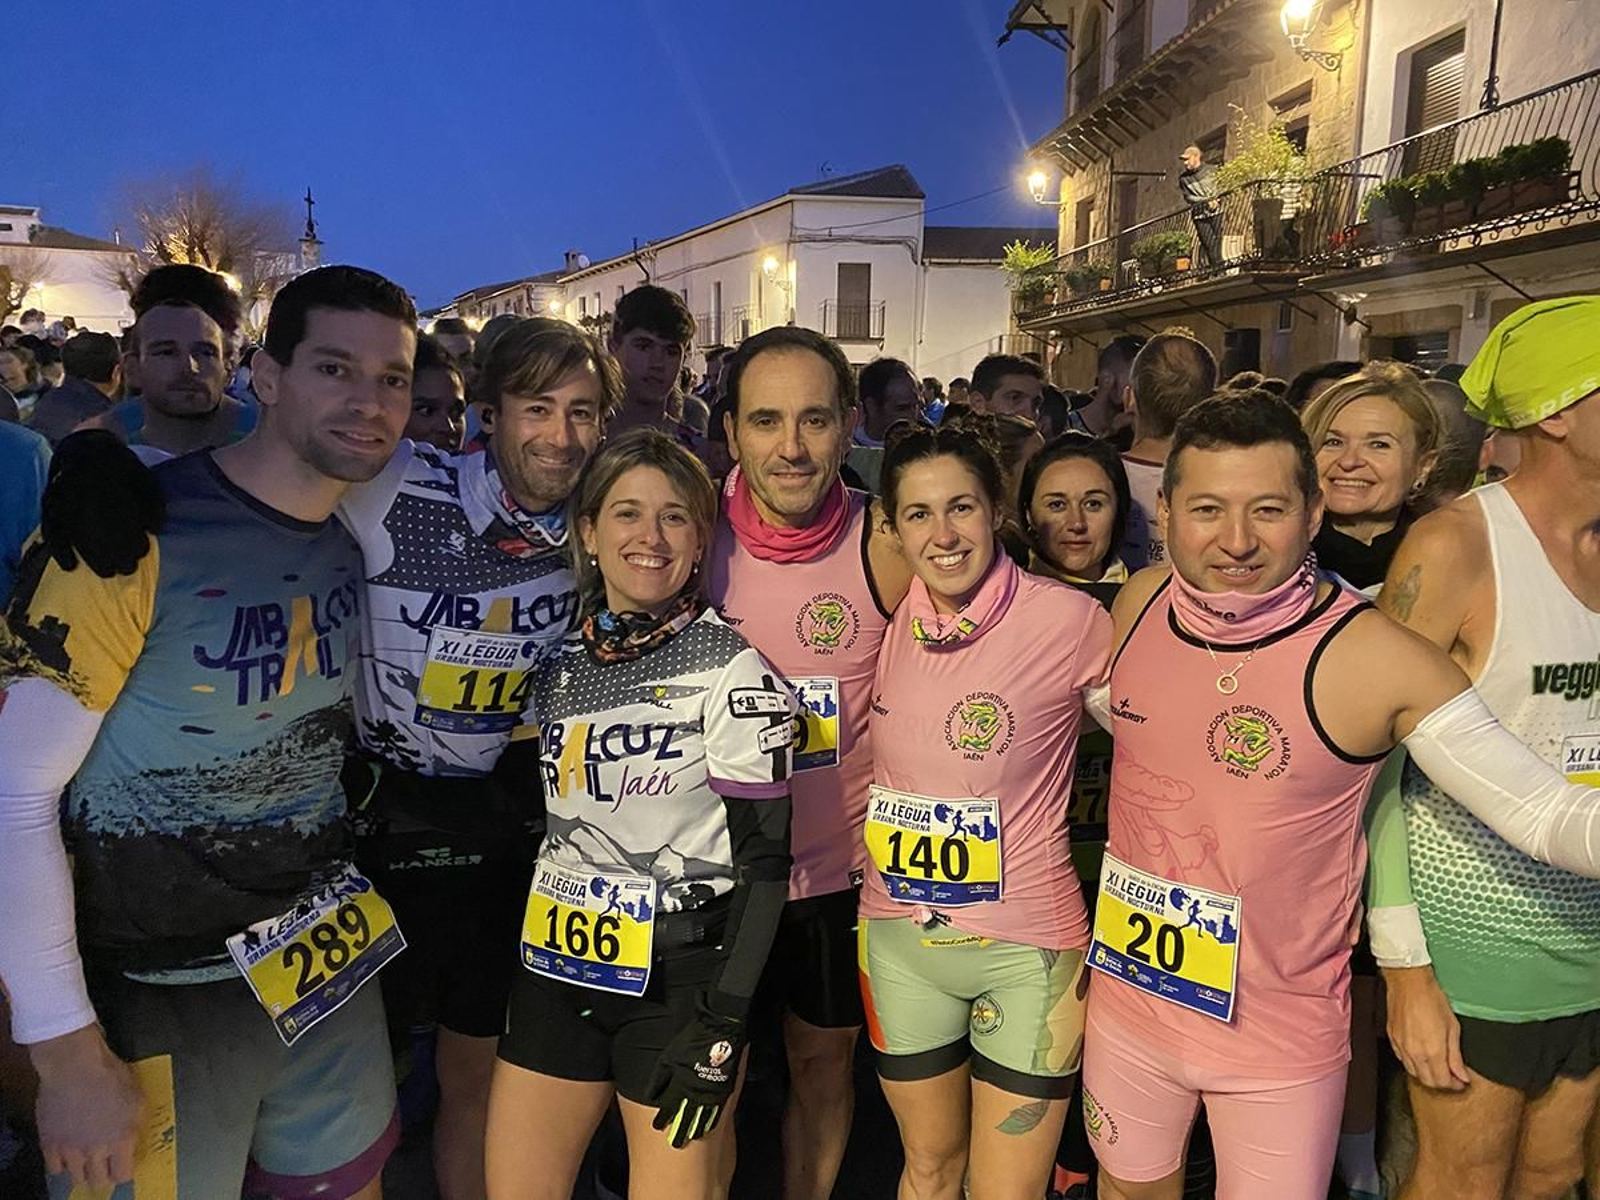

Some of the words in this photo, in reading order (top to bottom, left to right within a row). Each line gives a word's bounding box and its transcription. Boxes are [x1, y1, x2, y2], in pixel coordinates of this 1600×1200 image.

[226, 637, 342, 705] TRAIL
[437, 640, 461, 655] XI
[462, 643, 519, 661] LEGUA
[452, 669, 536, 712] 114
[944, 700, 964, 751] ASOCIACION
[965, 692, 1009, 712] DEPORTIVA
[996, 711, 1016, 757] MARATON
[1206, 710, 1230, 763] ASOCIACION
[1231, 704, 1284, 735] DEPORTIVA
[1263, 736, 1292, 781] MARATON
[1567, 748, 1586, 763] XI
[611, 764, 678, 813] Jaén
[874, 799, 889, 814] XI
[891, 803, 932, 823] LEGUA
[897, 819, 931, 833] NOCTURNA
[886, 830, 970, 882] 140
[539, 870, 552, 887] XI
[551, 875, 587, 899] LEGUA
[1105, 869, 1120, 888] XI
[1120, 879, 1167, 908] LEGUA
[1126, 896, 1165, 917] NOCTURNA
[283, 903, 370, 998] 289
[543, 904, 620, 963] 166
[1126, 912, 1185, 973] 20
